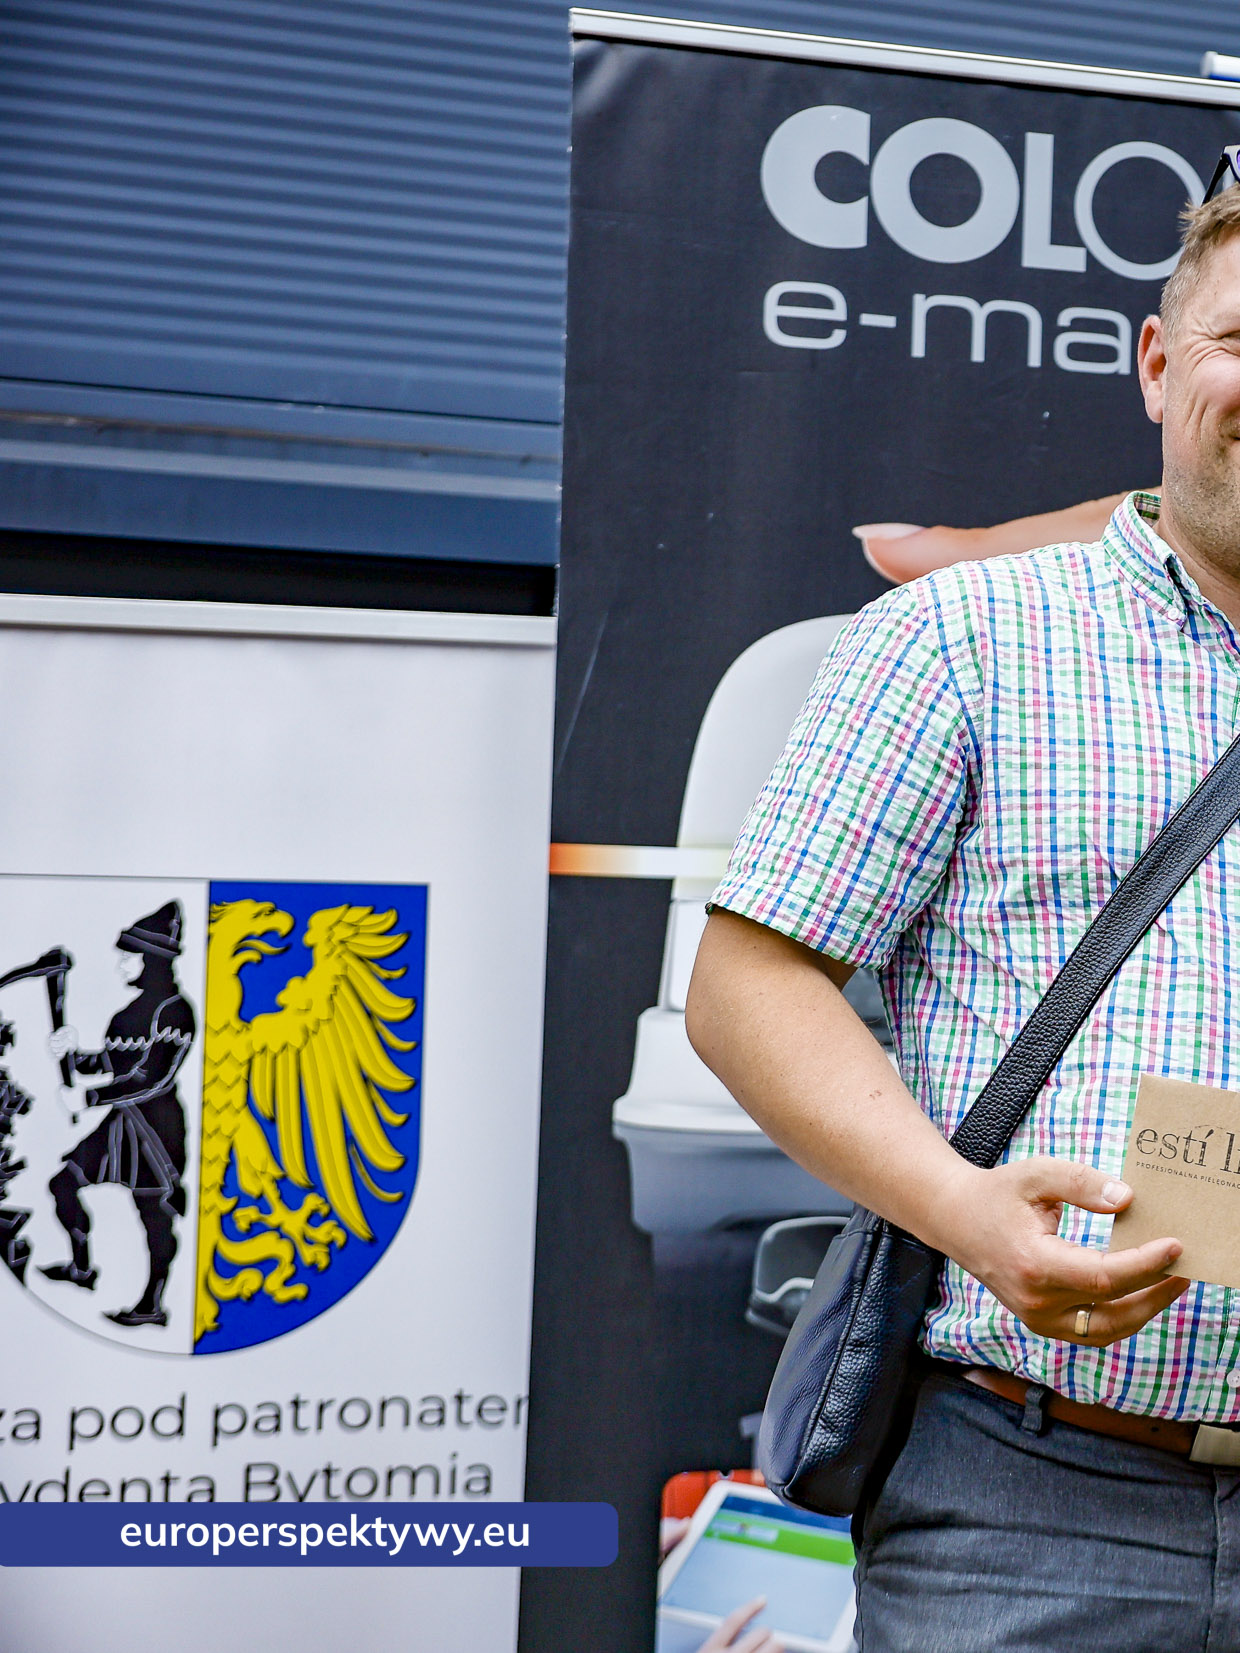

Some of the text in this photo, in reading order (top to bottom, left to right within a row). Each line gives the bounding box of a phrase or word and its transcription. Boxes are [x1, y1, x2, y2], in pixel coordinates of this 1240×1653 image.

[760, 104, 1210, 281] COLO
[68, 1392, 187, 1452] pod
[210, 1388, 529, 1447] patronate
[242, 1451, 494, 1502] Bytomia
